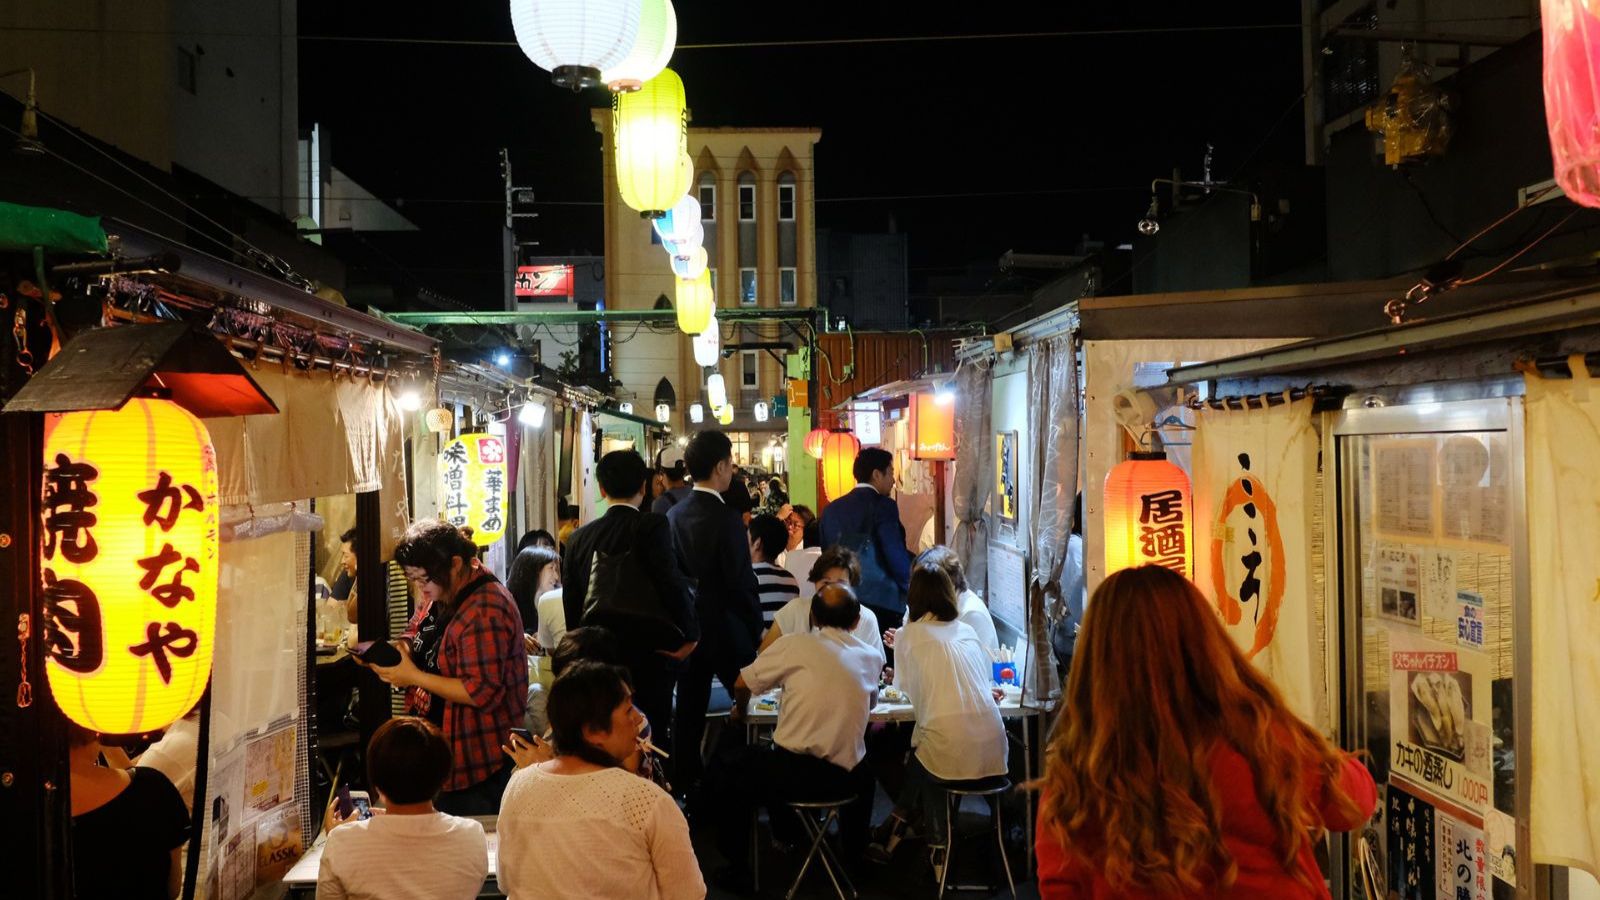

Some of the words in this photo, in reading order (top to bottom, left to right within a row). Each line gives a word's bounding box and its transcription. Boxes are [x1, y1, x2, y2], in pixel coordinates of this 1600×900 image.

[481, 469, 503, 531] 華まめ
[129, 472, 205, 685] かなや
[1396, 741, 1453, 789] カキの酒蒸し
